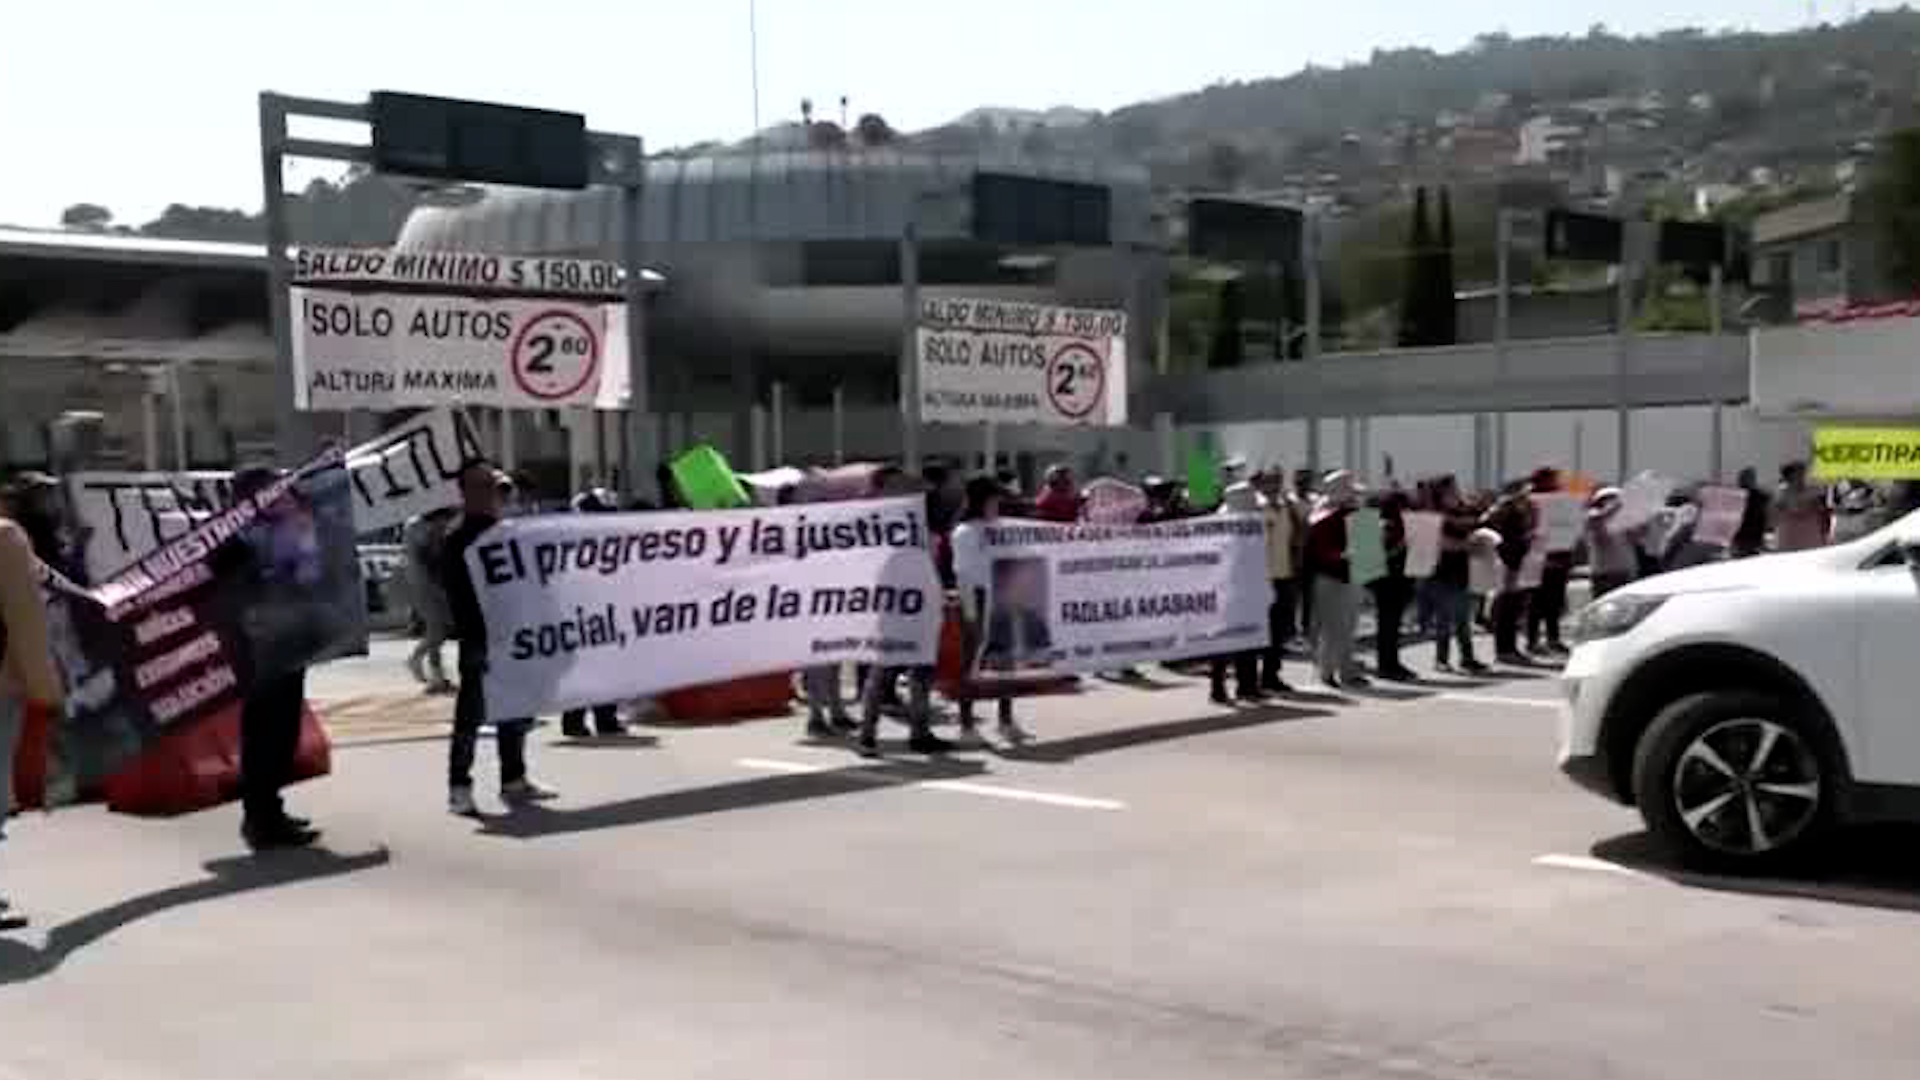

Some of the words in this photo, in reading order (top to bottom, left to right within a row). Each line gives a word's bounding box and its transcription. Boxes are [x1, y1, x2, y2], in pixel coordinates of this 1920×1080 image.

[392, 254, 499, 284] MINIMO
[310, 304, 394, 338] SOLO
[408, 309, 513, 341] AUTOS
[979, 341, 1046, 369] AUTOS
[403, 370, 497, 391] MAXIMA
[479, 541, 525, 587] El
[534, 526, 706, 588] progreso
[714, 524, 743, 566] y
[750, 517, 785, 555] la
[511, 602, 628, 662] social,
[632, 602, 699, 638] van
[708, 588, 757, 627] de
[764, 584, 800, 621] la
[808, 583, 924, 617] mano
